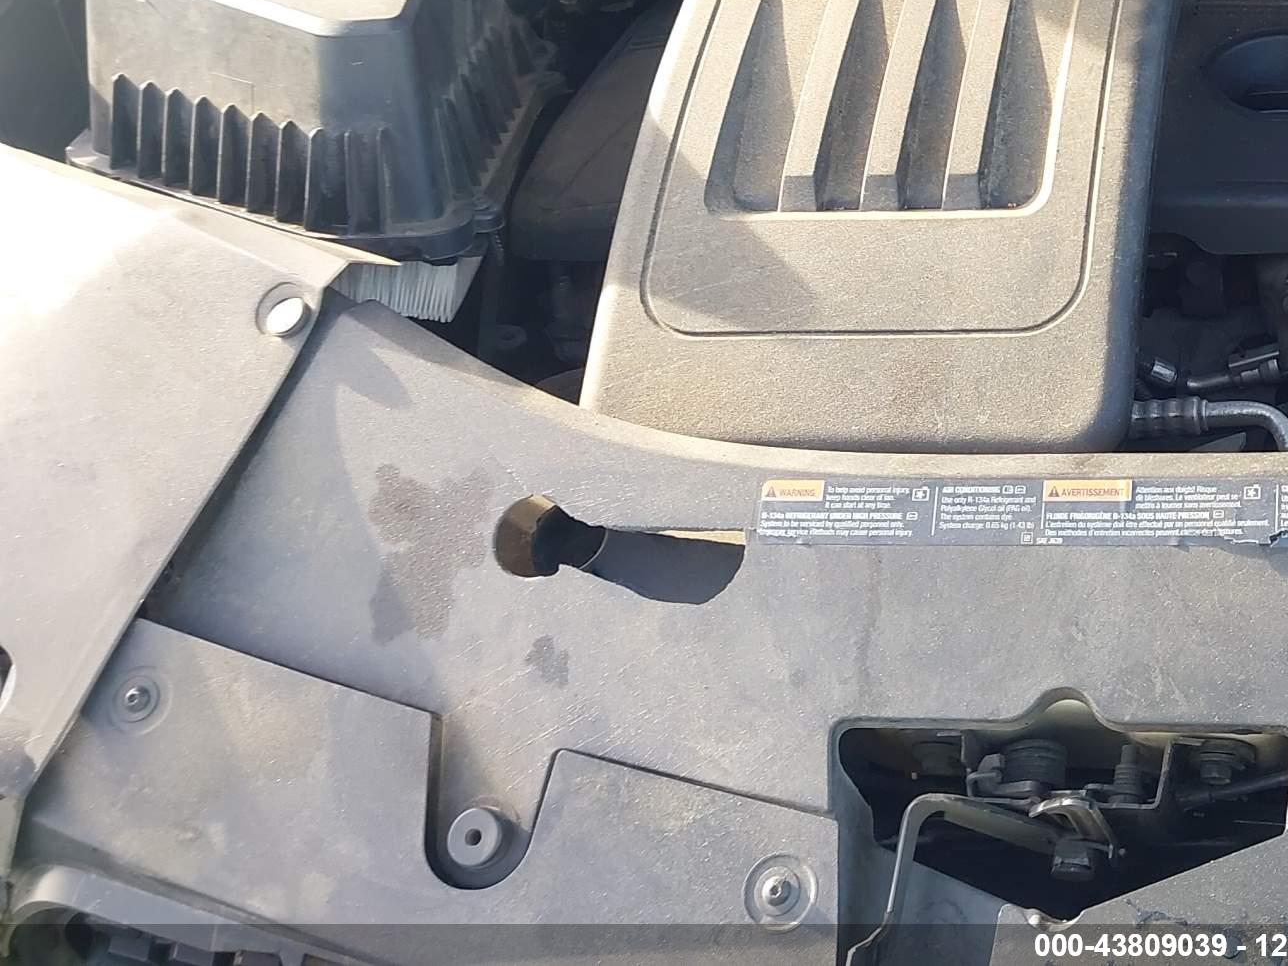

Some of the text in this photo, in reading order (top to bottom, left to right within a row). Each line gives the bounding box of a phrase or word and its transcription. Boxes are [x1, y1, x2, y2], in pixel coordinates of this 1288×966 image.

[780, 488, 816, 496] WARNING
[866, 486, 891, 494] personal
[955, 486, 1000, 494] CONDITIONING
[1061, 488, 1124, 496] AVERTISSEMENT
[1178, 512, 1209, 520] PRESSION
